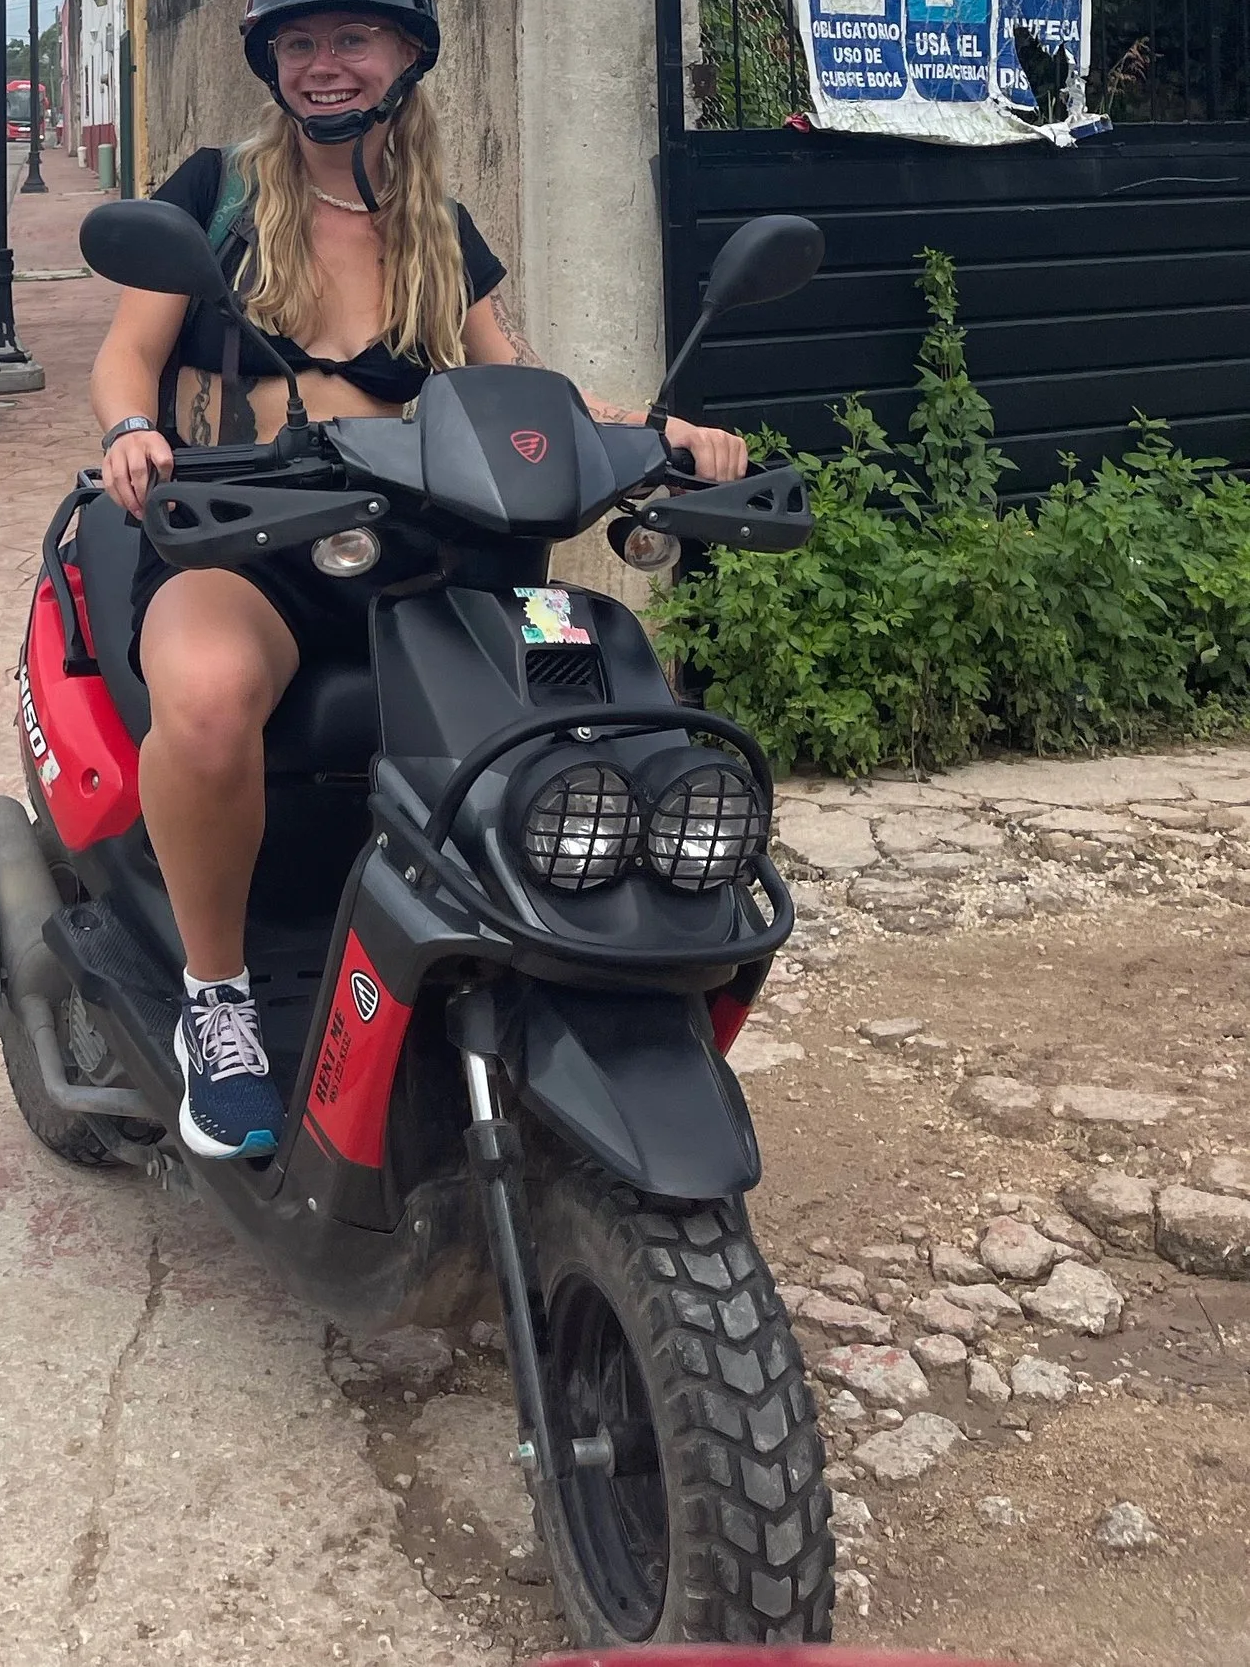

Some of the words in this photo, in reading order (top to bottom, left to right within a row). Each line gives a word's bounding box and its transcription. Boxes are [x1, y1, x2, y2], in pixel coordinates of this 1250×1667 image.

[813, 20, 900, 41] OBLIGATORIO
[915, 32, 951, 56] USA
[833, 47, 862, 63] USO
[864, 47, 882, 63] DE
[822, 70, 865, 87] CUBRE
[867, 71, 902, 87] BOCA
[316, 1043, 335, 1106] RENT
[330, 1007, 345, 1046] ME
